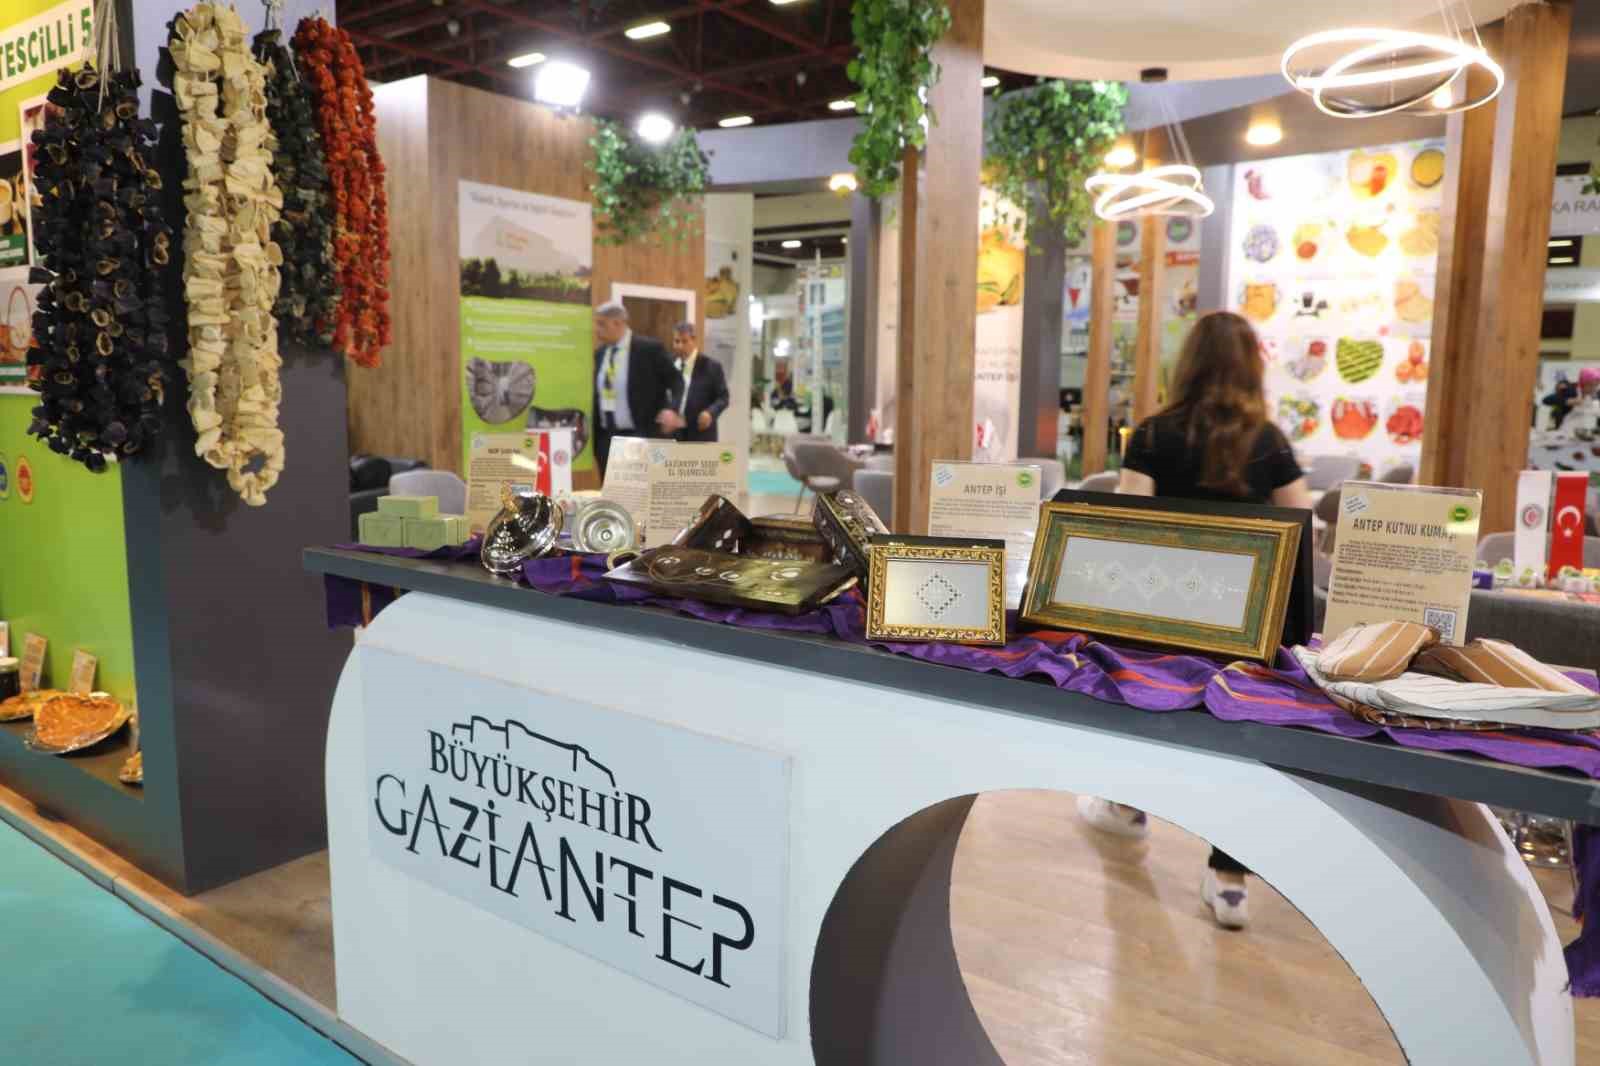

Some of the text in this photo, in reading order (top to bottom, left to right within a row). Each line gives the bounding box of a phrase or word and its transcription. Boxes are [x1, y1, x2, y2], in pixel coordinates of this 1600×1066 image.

[962, 483, 993, 495] ANTEP
[1353, 518, 1383, 532] ANTEP
[1385, 521, 1417, 536] KUTNU
[428, 729, 663, 852] BÜYÜKŞEHİR
[374, 773, 755, 988] GAZİANTEP
